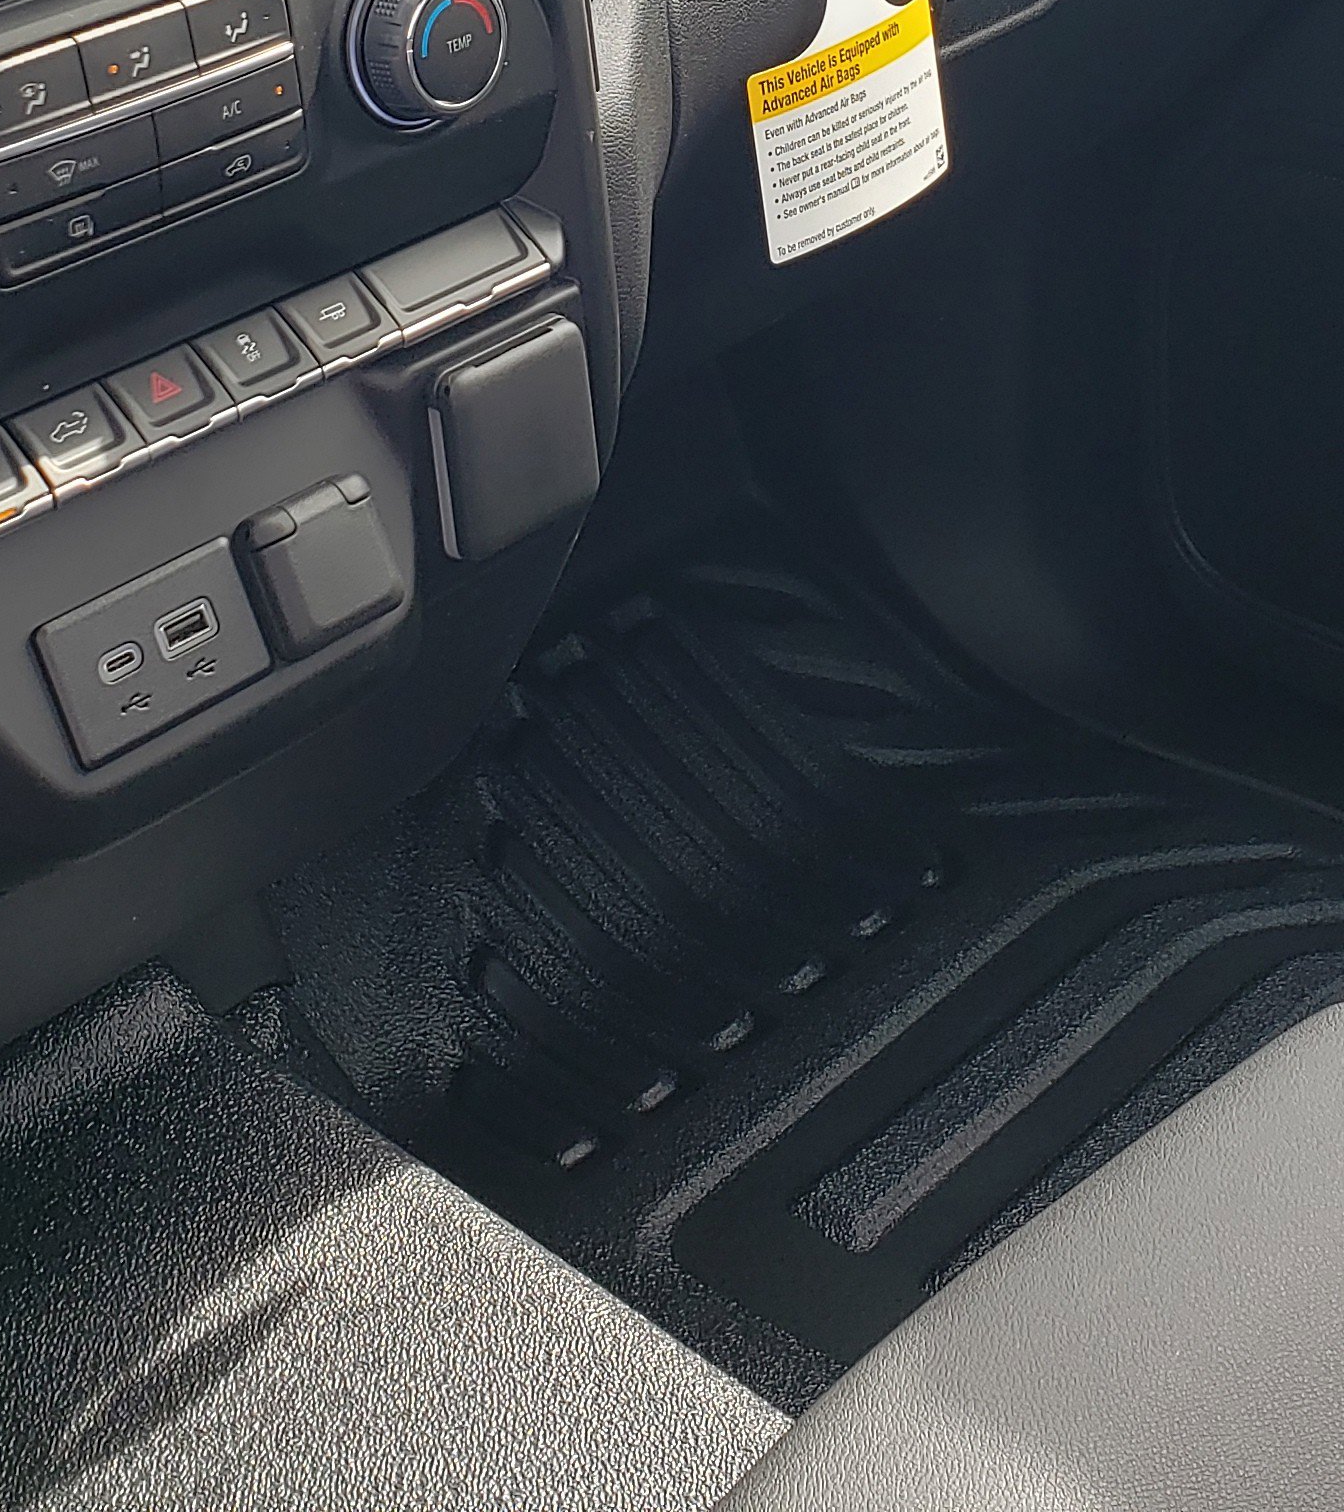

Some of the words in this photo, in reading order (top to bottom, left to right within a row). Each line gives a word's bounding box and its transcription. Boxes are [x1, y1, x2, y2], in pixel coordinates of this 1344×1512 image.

[446, 33, 472, 53] TEMP
[758, 76, 784, 96] This
[787, 59, 826, 85] Vehicle
[828, 53, 838, 68] is
[839, 32, 880, 63] Equipped
[882, 22, 900, 41] with
[222, 99, 242, 120] A/C
[762, 80, 817, 114] Advanced
[820, 75, 834, 92] Air
[837, 64, 860, 86] Bags
[765, 127, 784, 140] Even
[786, 117, 803, 132] with
[805, 101, 838, 125] Advanced
[840, 97, 849, 110] Air
[850, 90, 866, 104] Bags
[775, 138, 806, 156] Children
[807, 132, 820, 143] can
[822, 126, 830, 137] be
[832, 116, 849, 131] killed
[851, 114, 857, 124] or
[858, 100, 884, 120] seriously
[777, 160, 790, 172] The
[792, 152, 809, 166] back
[810, 145, 825, 158] seat
[826, 143, 832, 152] is
[833, 138, 843, 148] the
[845, 127, 862, 143] safest
[863, 120, 878, 135] place
[779, 173, 800, 187] Never
[802, 168, 813, 181] put
[820, 148, 855, 171] rear-facing
[856, 139, 870, 154] child
[871, 133, 882, 146] seat
[884, 131, 888, 139] in
[782, 186, 807, 204] Always
[809, 182, 820, 193] use
[822, 173, 836, 187] seat
[837, 166, 852, 180] belts
[854, 159, 865, 172] and
[866, 151, 879, 165] child
[784, 207, 797, 219] See
[799, 195, 826, 213] owner's
[827, 183, 850, 201] manual
[871, 166, 885, 179] more
[777, 246, 786, 257] To
[788, 243, 796, 253] be
[798, 228, 826, 248] removed
[827, 227, 835, 236] by
[836, 214, 862, 232] customer
